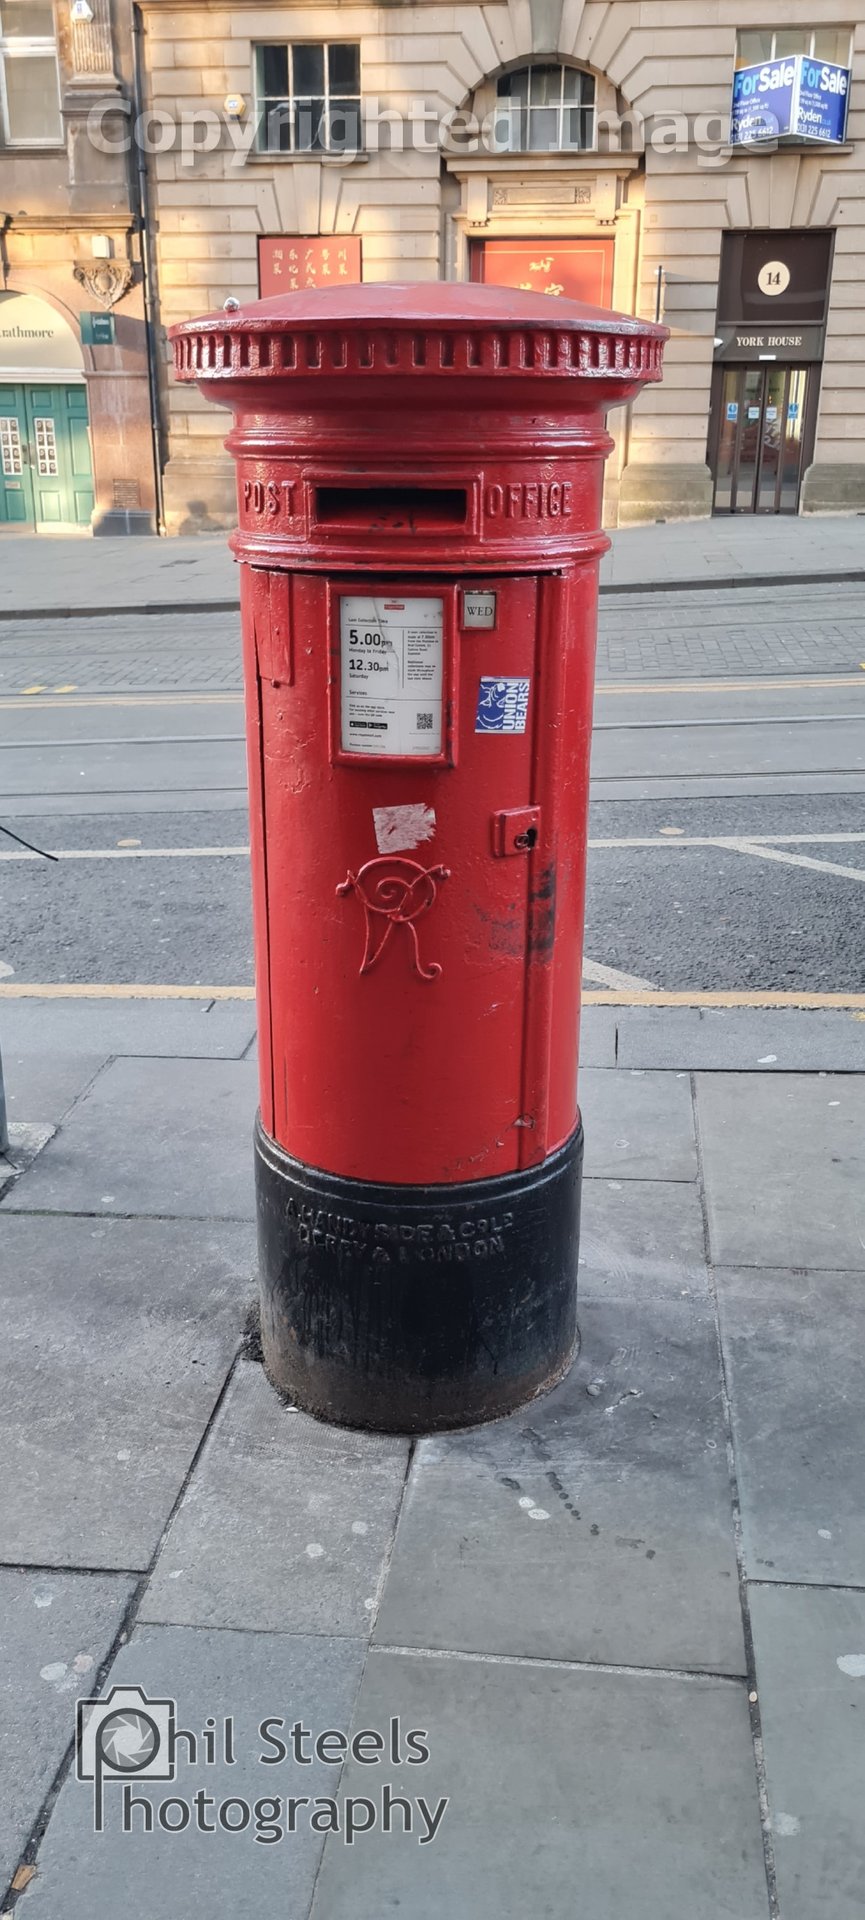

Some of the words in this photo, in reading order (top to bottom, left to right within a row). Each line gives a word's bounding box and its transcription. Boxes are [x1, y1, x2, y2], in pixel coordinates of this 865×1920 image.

[766, 271, 781, 286] 14
[0, 326, 54, 338] rathmore
[736, 336, 765, 347] YORK
[767, 336, 803, 346] HOUSE
[244, 480, 297, 517] POST
[485, 481, 574, 519] OFFICE
[467, 606, 493, 617] WED
[349, 659, 389, 672] 12.30pm
[502, 682, 519, 731] UNION
[514, 682, 530, 731] BEARS
